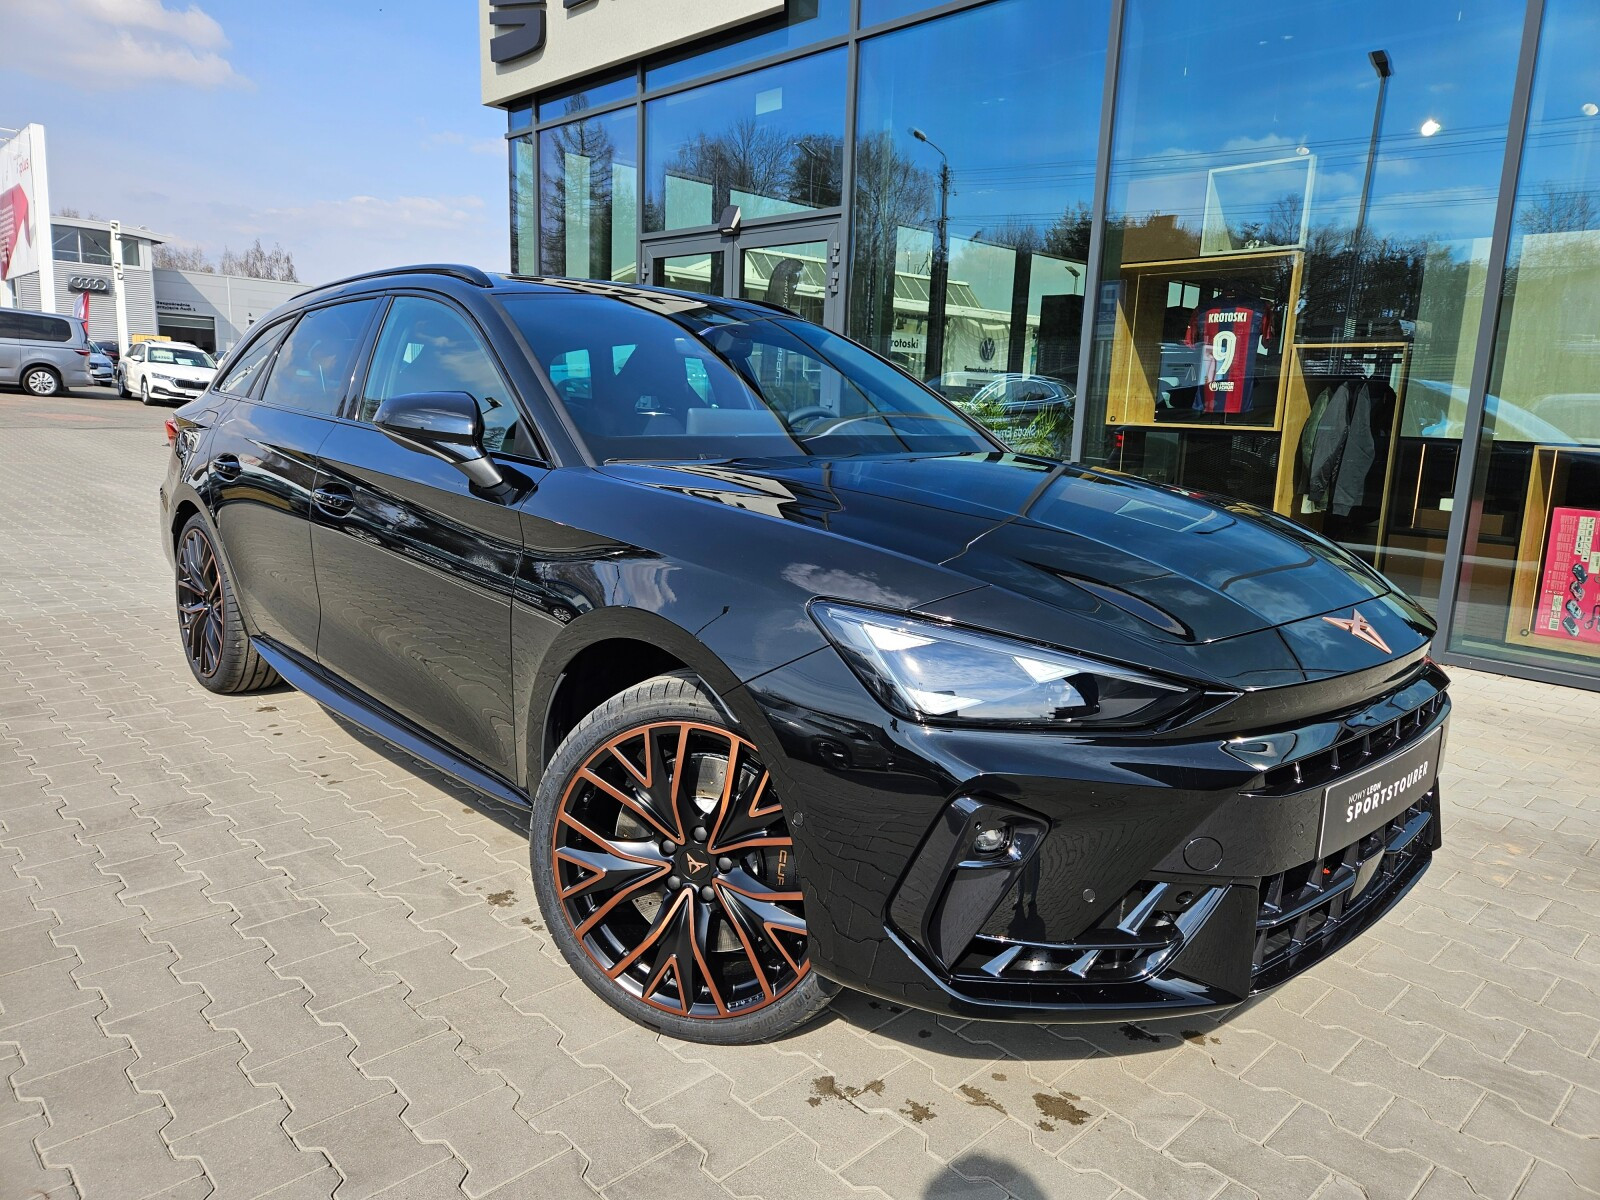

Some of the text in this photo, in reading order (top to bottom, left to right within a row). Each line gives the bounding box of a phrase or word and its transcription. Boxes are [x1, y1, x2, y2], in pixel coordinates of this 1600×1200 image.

[1208, 312, 1247, 323] KROTOSKI
[1212, 330, 1237, 375] 9
[1346, 760, 1429, 823] SPORTSTOURER
[1348, 781, 1382, 804] NOWY LEON
